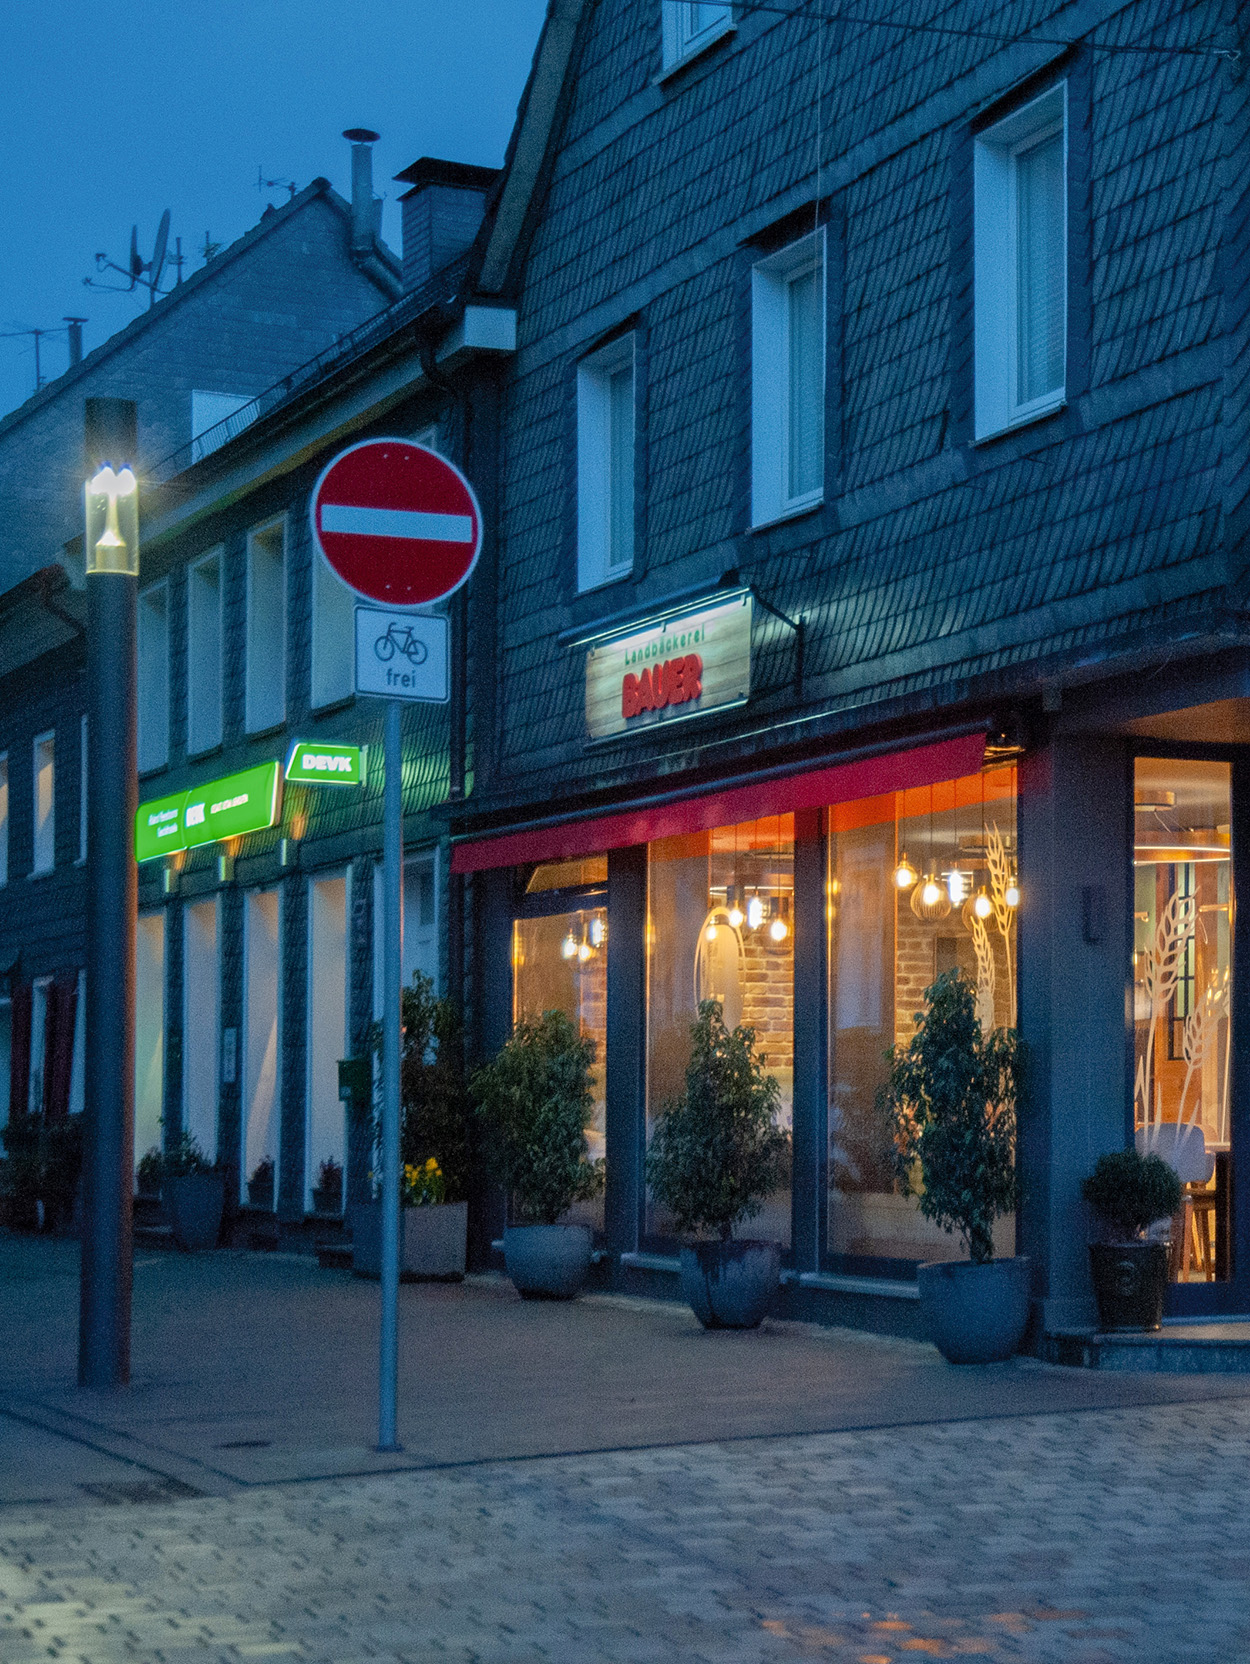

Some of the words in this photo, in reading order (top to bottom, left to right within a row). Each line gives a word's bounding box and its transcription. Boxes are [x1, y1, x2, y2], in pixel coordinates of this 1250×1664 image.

[625, 624, 705, 665] Landbäckerei
[386, 668, 416, 688] frei
[622, 653, 703, 719] BAUER
[302, 754, 353, 772] DEVK
